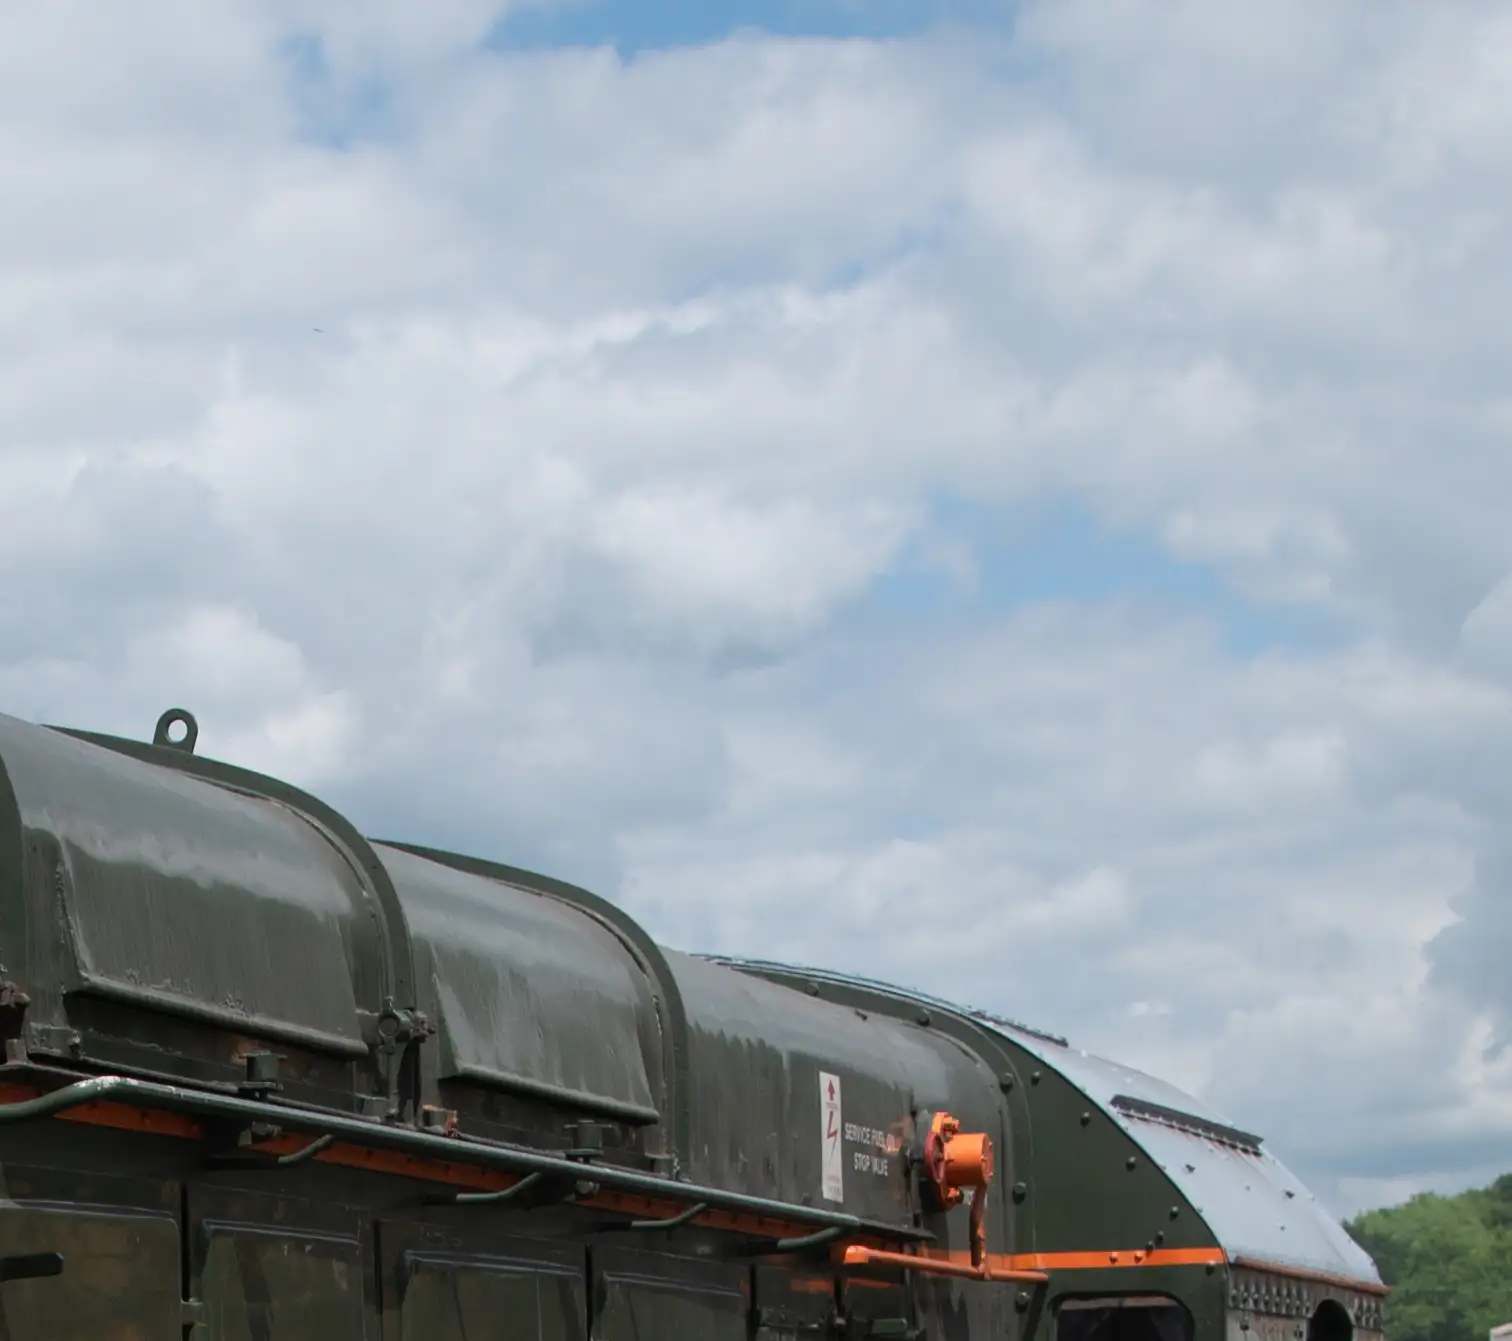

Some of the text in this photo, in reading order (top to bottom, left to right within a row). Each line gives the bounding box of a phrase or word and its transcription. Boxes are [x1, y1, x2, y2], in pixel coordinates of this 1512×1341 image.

[845, 1122, 870, 1145] SERVICE
[871, 1128, 885, 1147] FUEL
[854, 1152, 888, 1177] STOP VALVE
